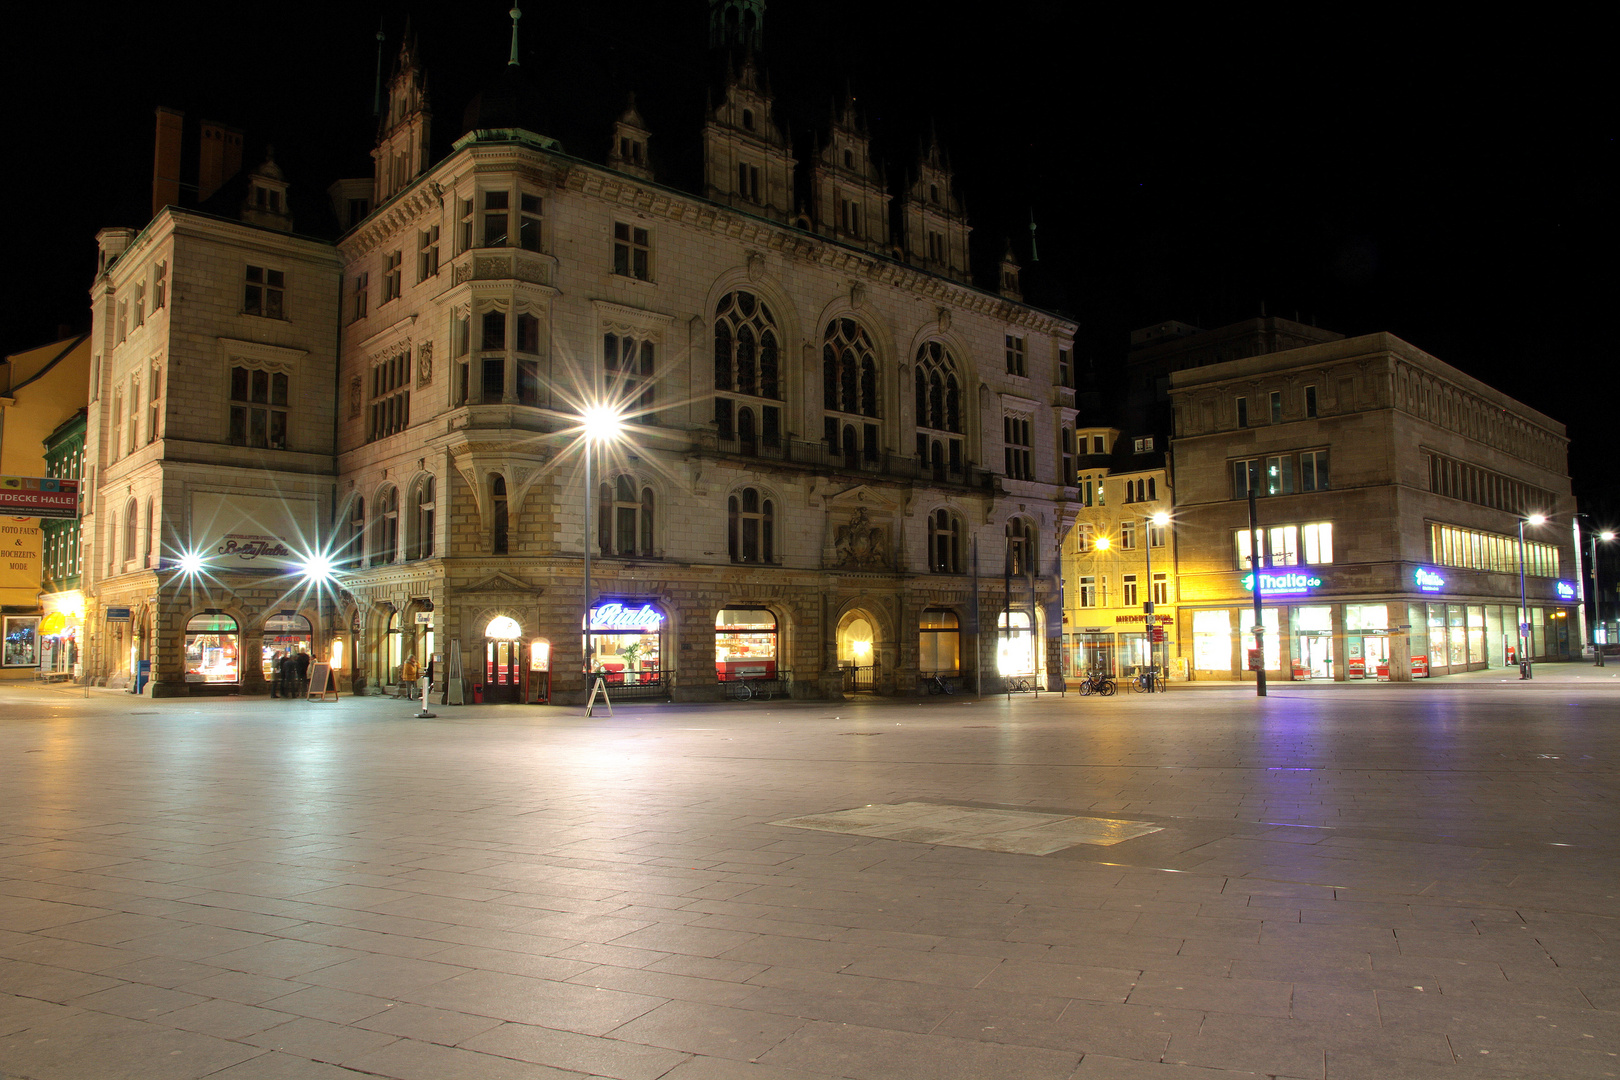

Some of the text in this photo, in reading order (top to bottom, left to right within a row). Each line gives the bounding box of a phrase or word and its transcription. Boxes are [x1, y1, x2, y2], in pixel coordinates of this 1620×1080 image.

[41, 496, 74, 504] HALLE!
[19, 527, 39, 535] FAUST
[10, 562, 27, 570] MODE
[591, 603, 665, 626] Rialto
